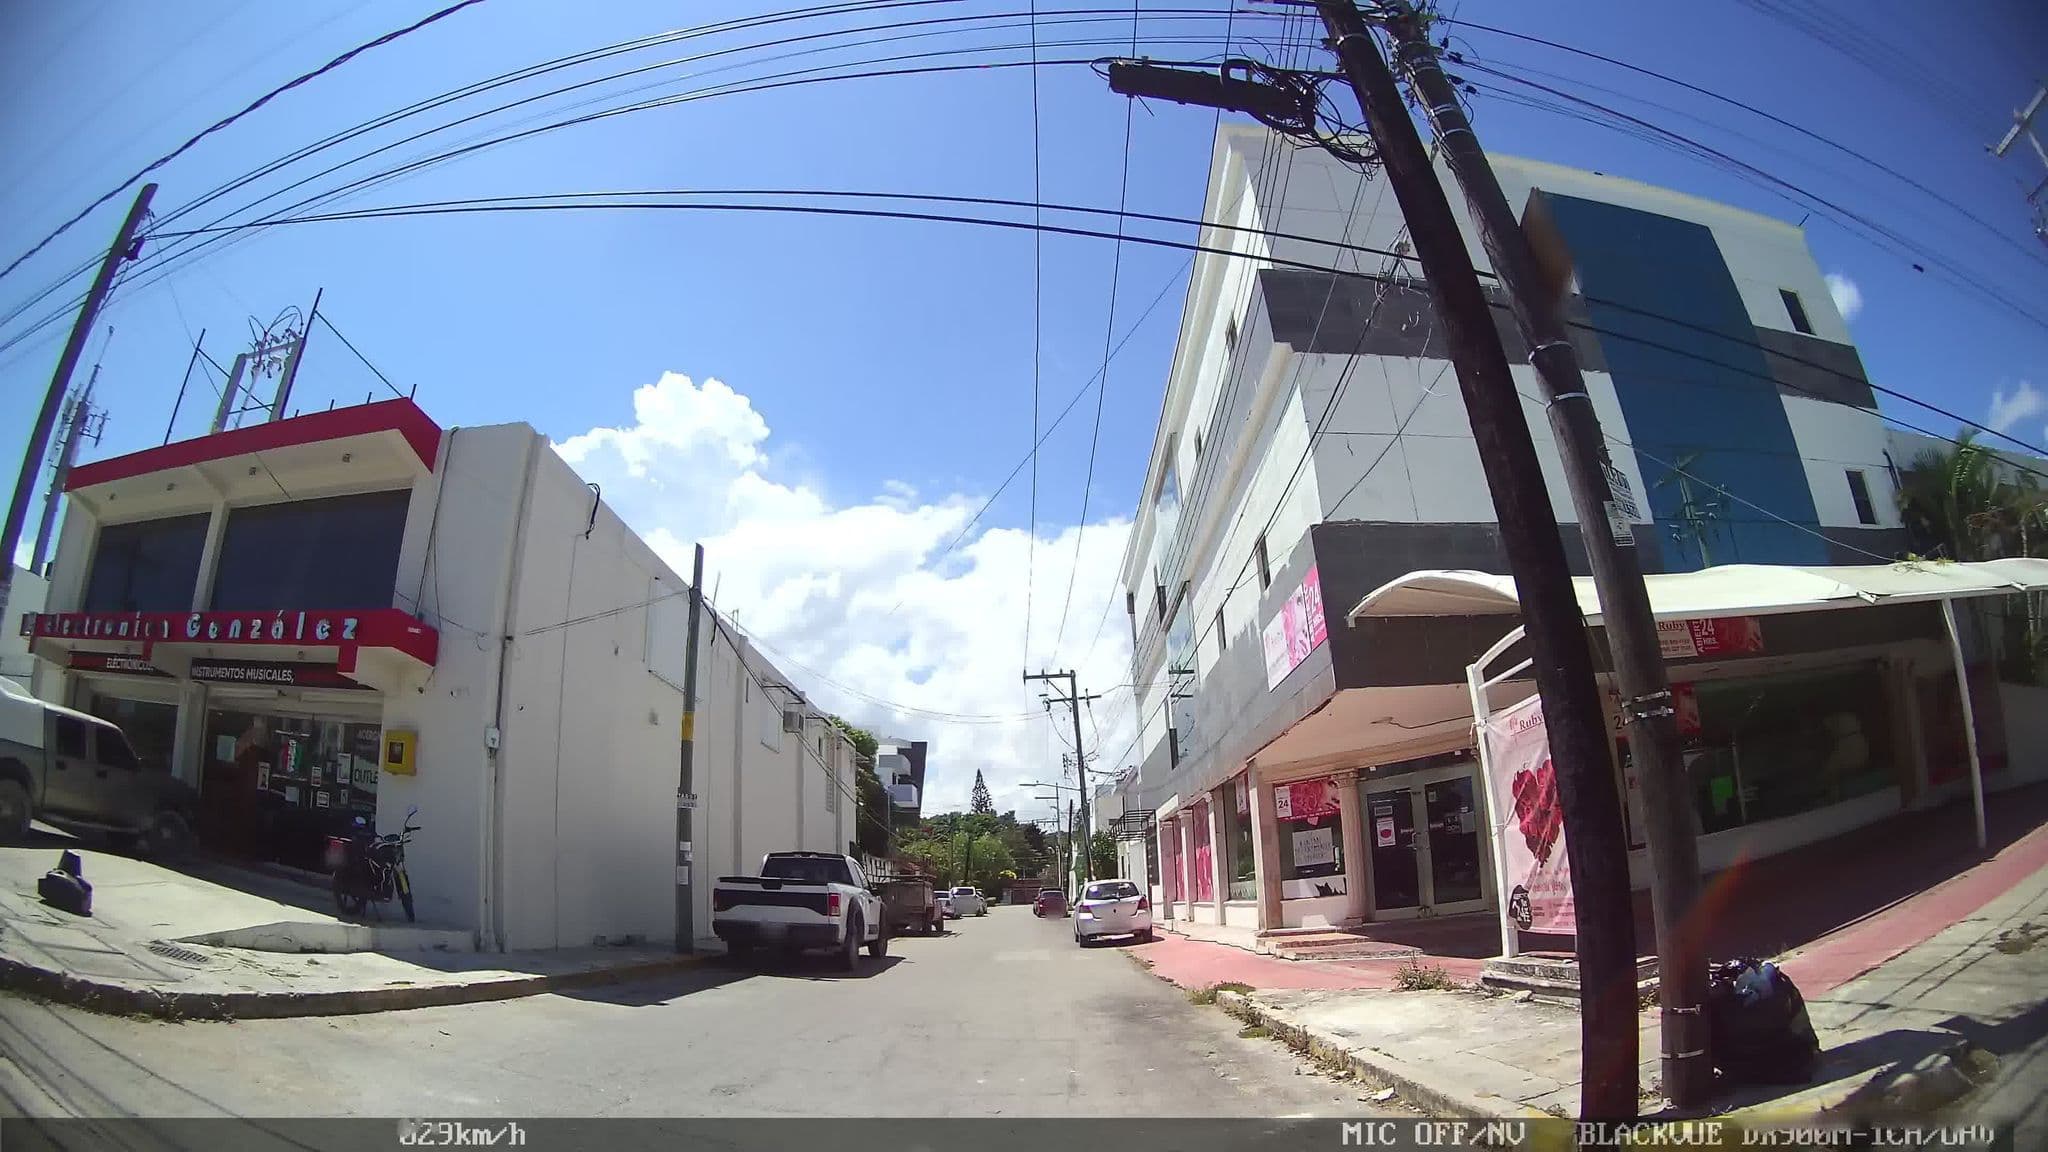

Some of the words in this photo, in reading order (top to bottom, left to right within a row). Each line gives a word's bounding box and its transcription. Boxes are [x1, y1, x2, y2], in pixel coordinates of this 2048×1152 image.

[186, 610, 358, 640] González
[1658, 620, 1686, 632] Ruby
[1700, 619, 1715, 636] 24
[192, 666, 245, 679] INSTRUMENTOS
[246, 668, 294, 683] MUSICALES,
[1519, 714, 1543, 730] Ruby
[1278, 799, 1289, 809] 24
